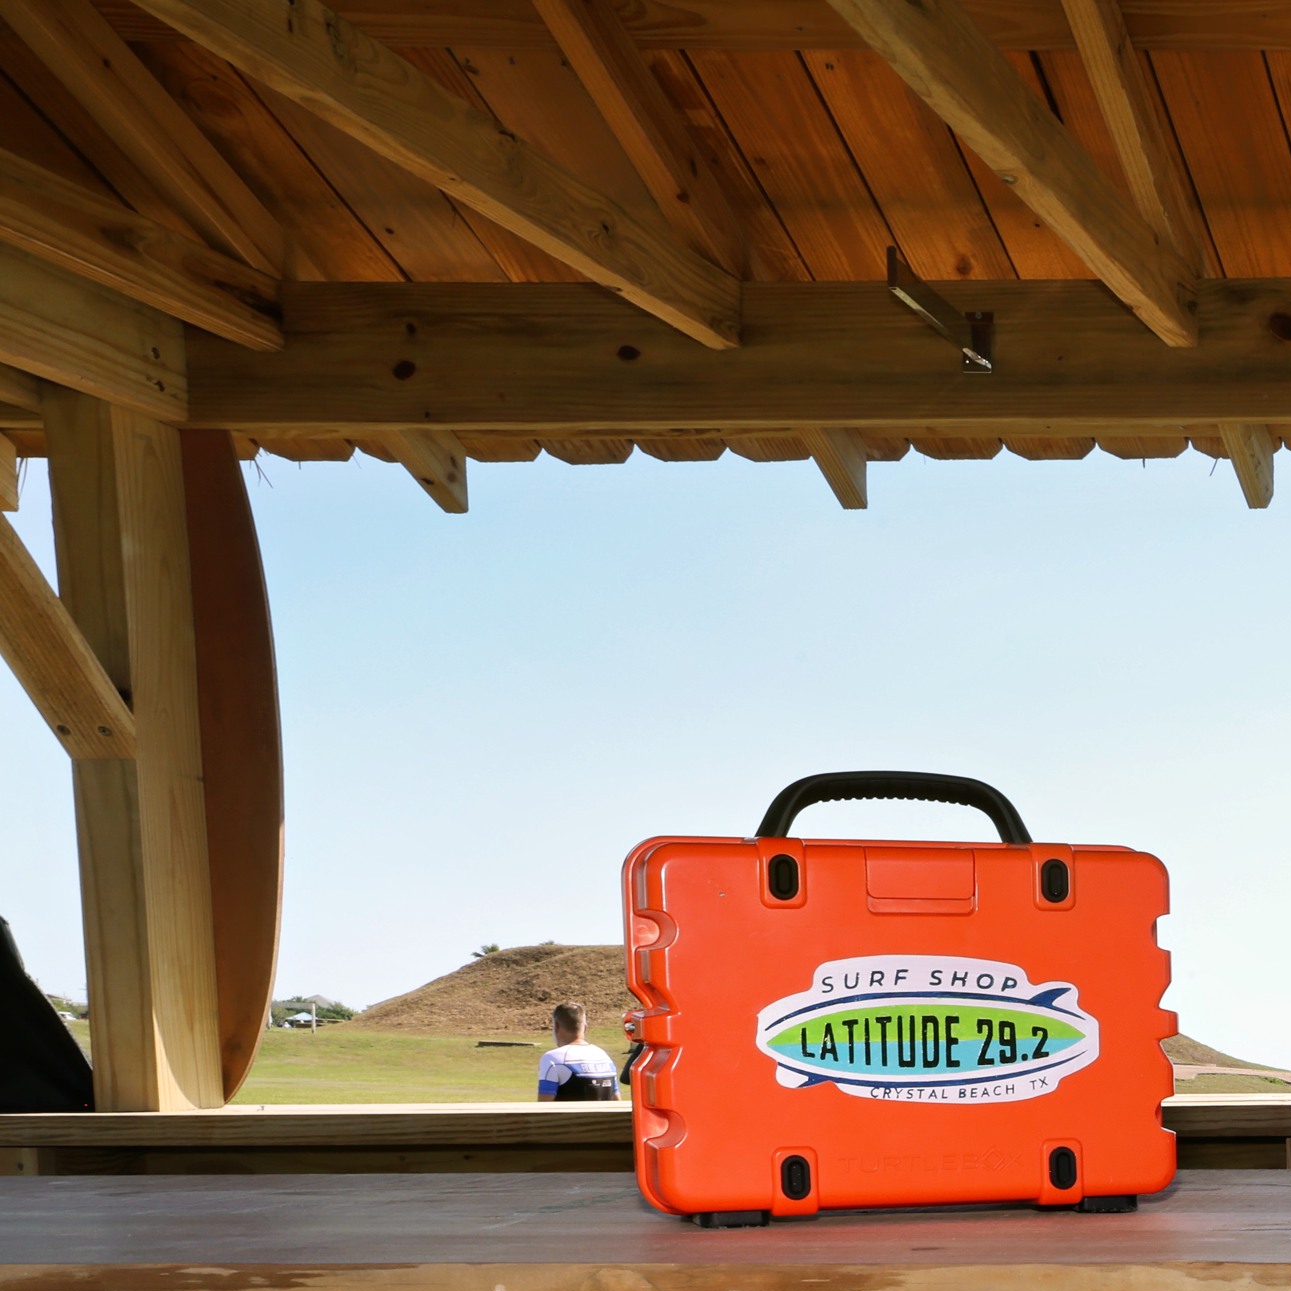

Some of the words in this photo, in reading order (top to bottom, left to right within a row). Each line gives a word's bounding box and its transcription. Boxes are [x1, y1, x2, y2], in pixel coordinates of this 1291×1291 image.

[821, 969, 909, 993] SURF
[929, 969, 1018, 992] SHOP
[800, 1015, 961, 1068] LATITUDE
[976, 1018, 1050, 1066] 29.2
[869, 1086, 949, 1100] CRYSTAL
[958, 1084, 1016, 1099] BEACH
[1030, 1076, 1049, 1091] TX
